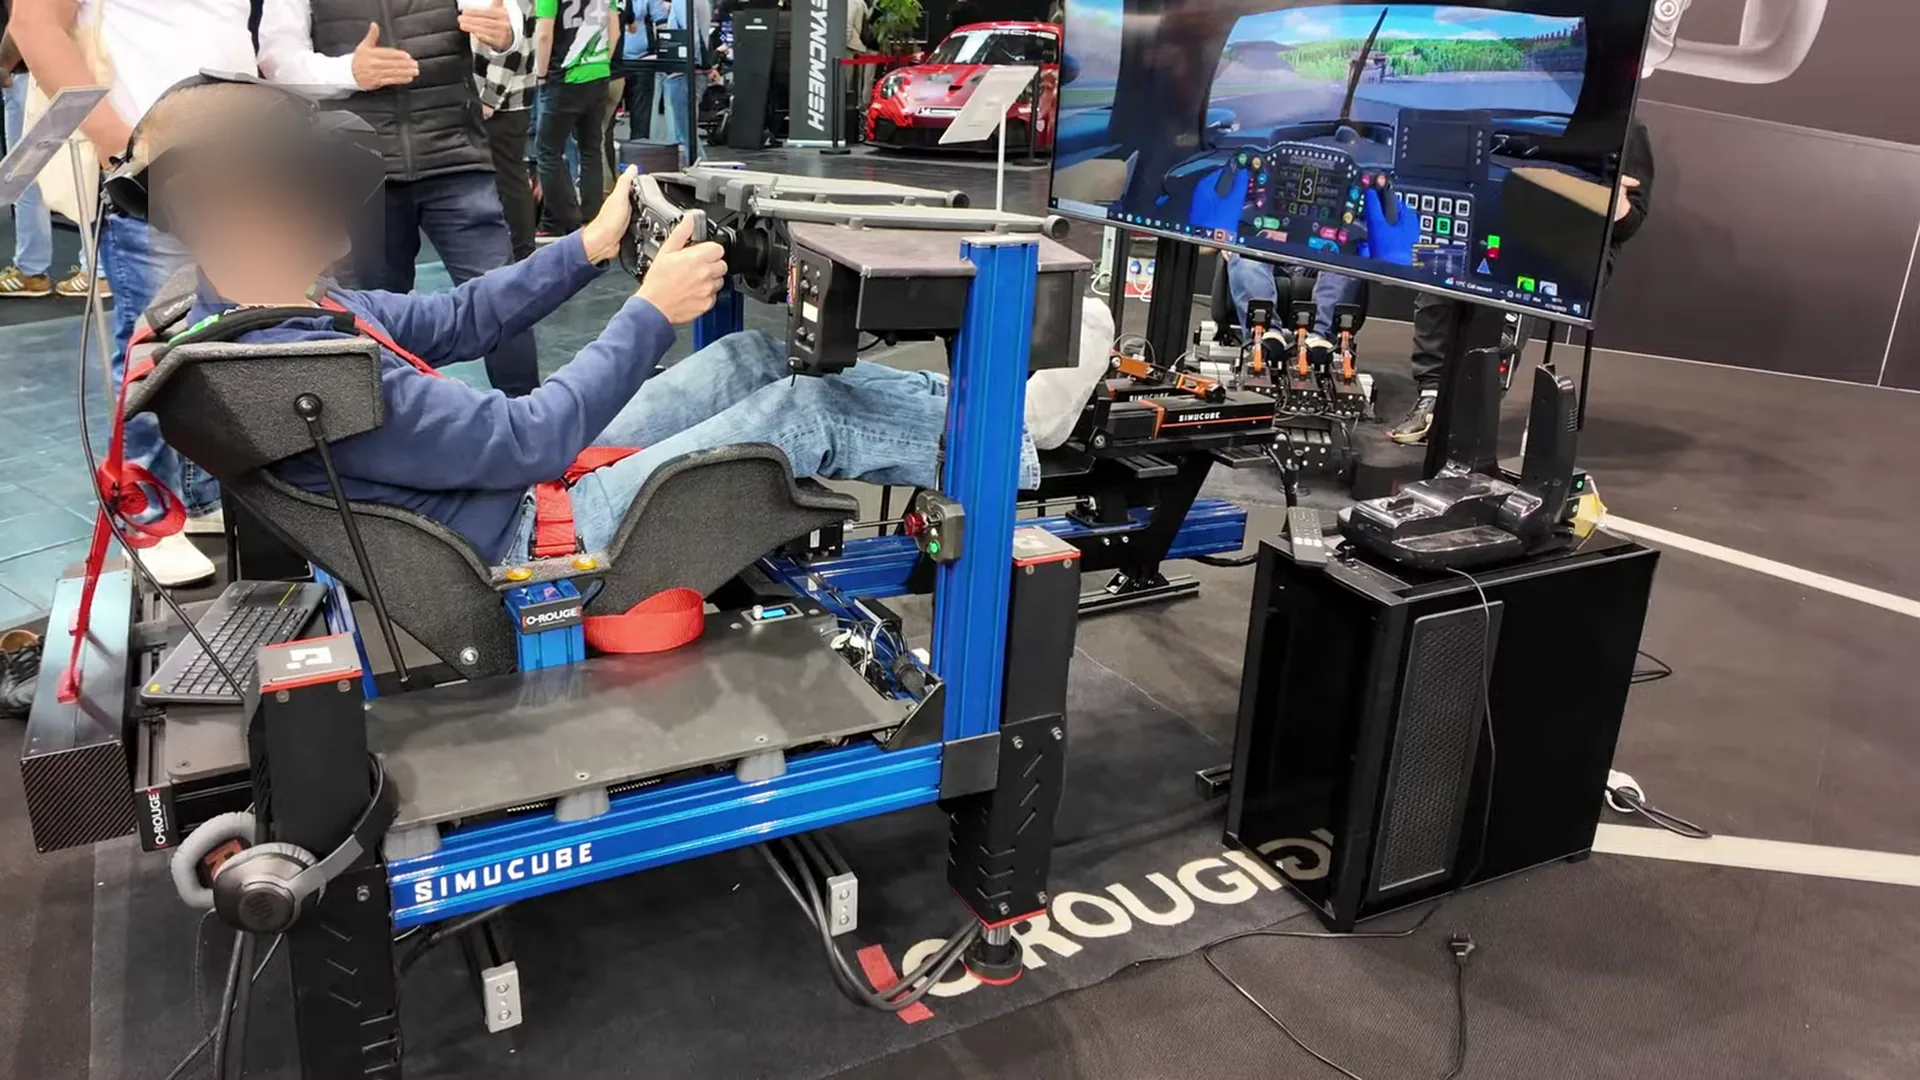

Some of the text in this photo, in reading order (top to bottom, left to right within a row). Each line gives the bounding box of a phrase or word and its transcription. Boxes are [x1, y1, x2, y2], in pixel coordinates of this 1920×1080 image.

[1302, 178, 1313, 196] 3
[1178, 412, 1221, 422] SIMUCUBE
[526, 607, 578, 625] O-ROUGE
[149, 792, 166, 845] O-ROUGE
[414, 843, 593, 903] SIMUCUBE
[902, 850, 1284, 998] OROUG
